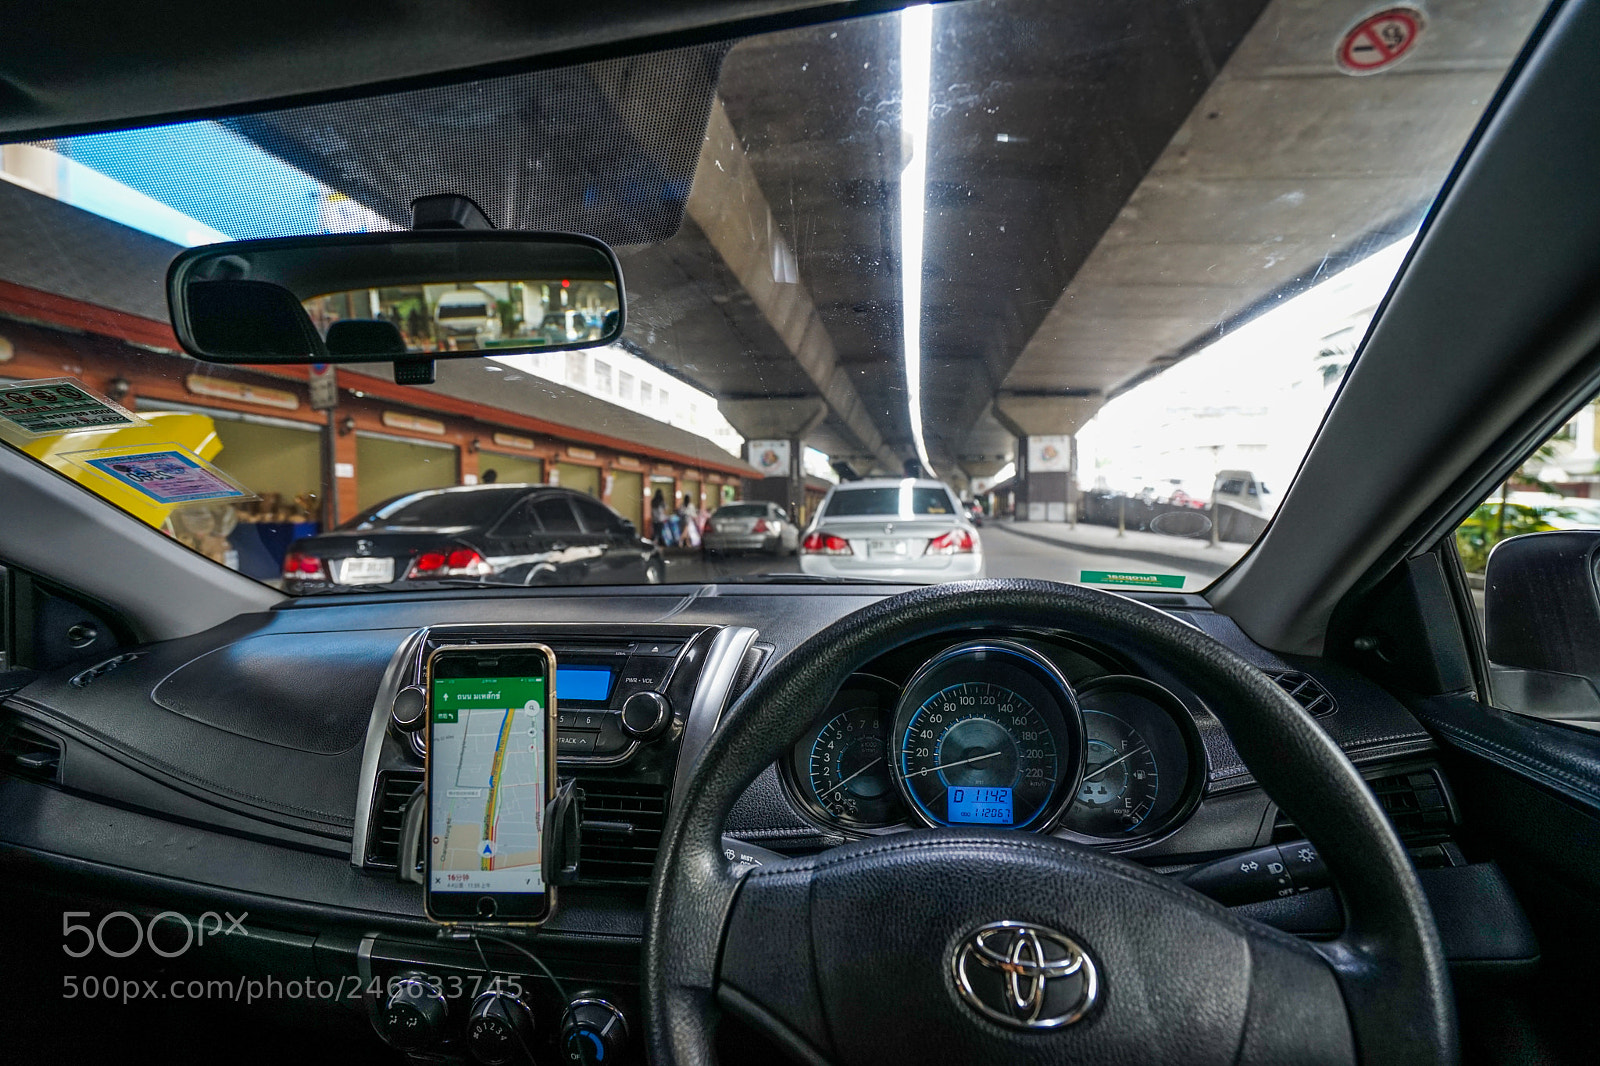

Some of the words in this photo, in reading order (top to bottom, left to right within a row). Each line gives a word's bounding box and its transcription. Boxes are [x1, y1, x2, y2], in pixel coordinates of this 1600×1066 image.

[959, 696, 976, 706] 100
[979, 696, 996, 705] 120
[943, 703, 957, 712] 80
[998, 703, 1014, 713] 140
[929, 714, 943, 723] 60
[1011, 717, 1028, 726] 160
[846, 723, 853, 731] 6
[860, 720, 866, 729] 7
[836, 730, 843, 740] 5
[920, 730, 934, 739] 40
[1022, 731, 1038, 741] 180
[827, 740, 835, 749] 4
[1121, 740, 1128, 750] F
[916, 748, 929, 757] 20
[1026, 749, 1044, 759] 200
[823, 753, 831, 762] 3
[823, 767, 830, 776] 2
[1025, 768, 1044, 778] 220
[834, 791, 842, 801] 0
[1124, 797, 1133, 808] E
[975, 808, 1011, 818] 112067
[1278, 887, 1294, 897] OFF
[490, 1022, 495, 1031] 2
